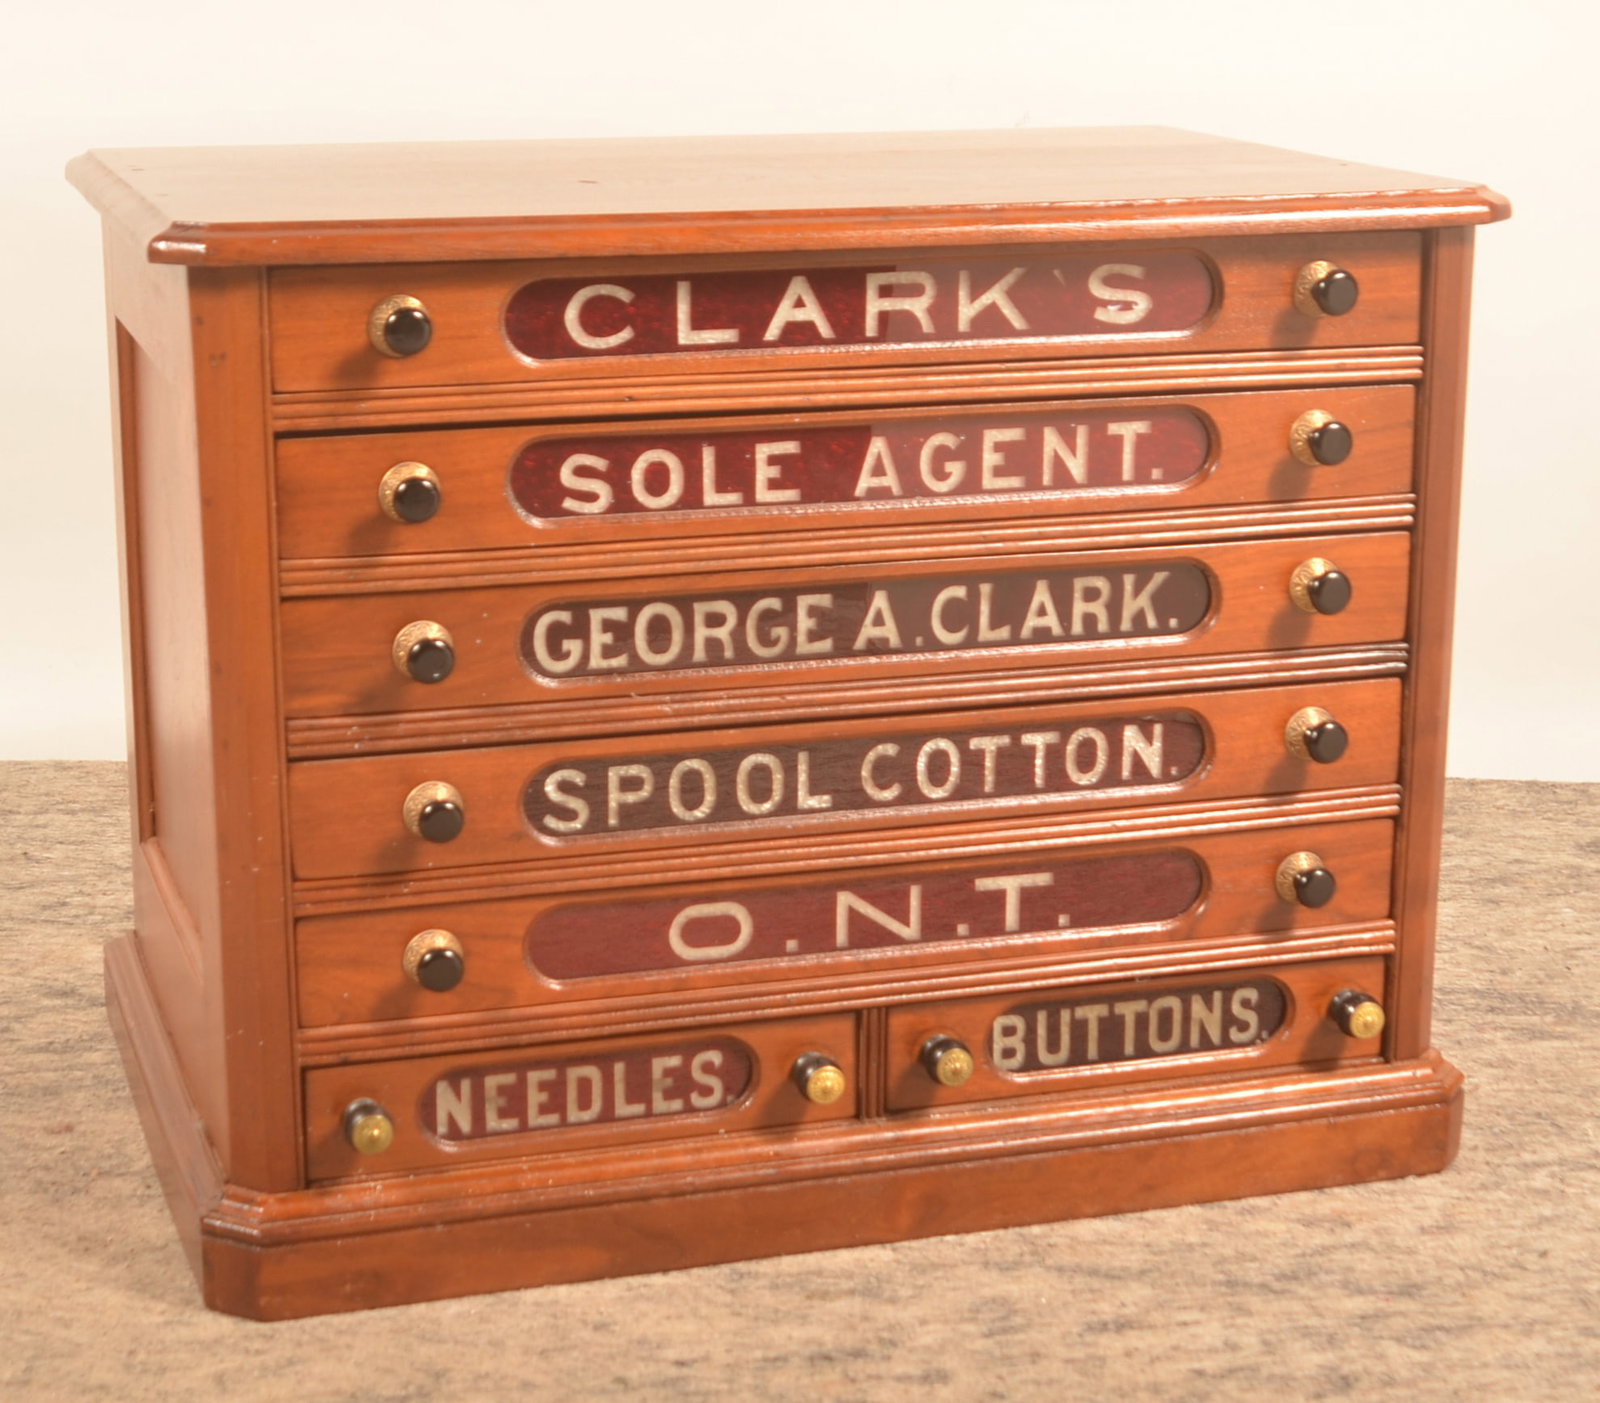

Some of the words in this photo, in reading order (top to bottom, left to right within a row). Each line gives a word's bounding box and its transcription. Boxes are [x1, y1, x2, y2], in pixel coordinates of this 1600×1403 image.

[559, 440, 801, 515] SOLE
[853, 420, 1165, 498] AGENT.
[532, 592, 833, 674] GEORGE
[852, 589, 924, 650] A.
[930, 570, 1180, 645] CLARK.
[542, 750, 832, 831] SPOOL
[860, 723, 1180, 801] COTTON.
[991, 986, 1269, 1071] BUTTONS.
[434, 1049, 737, 1136] NEEDLES.
